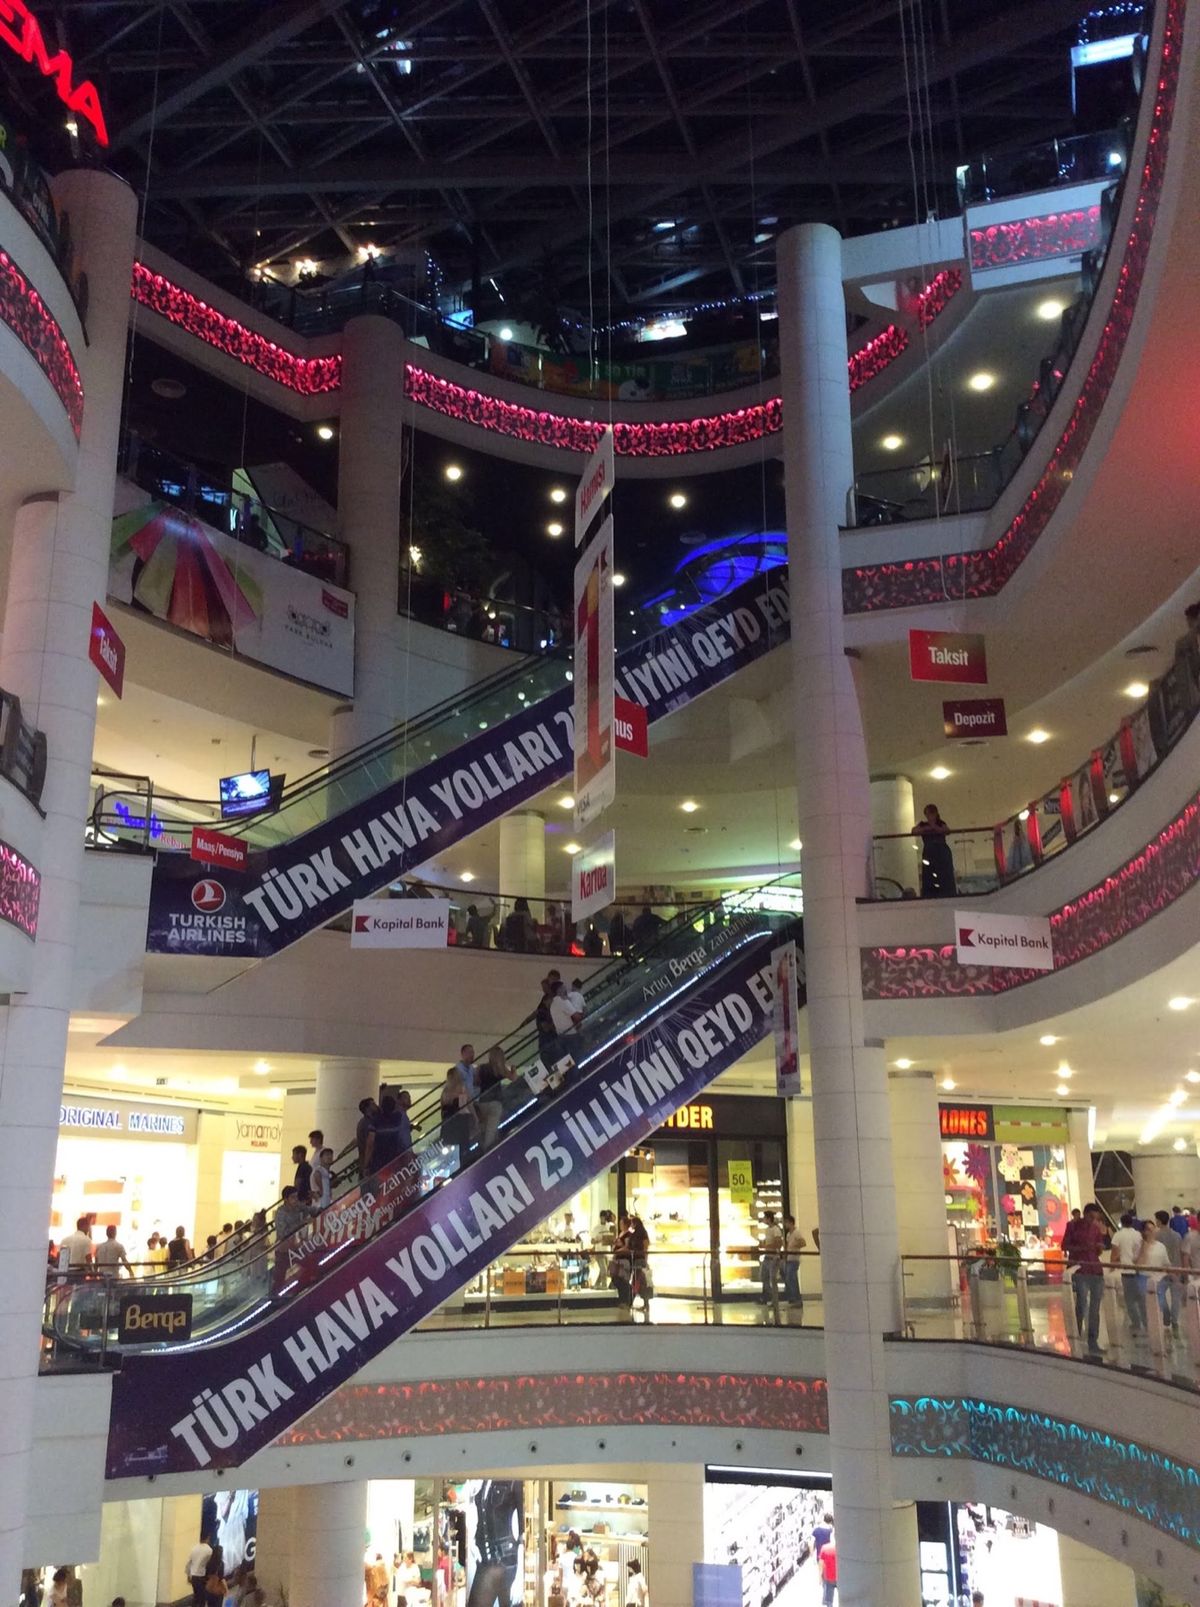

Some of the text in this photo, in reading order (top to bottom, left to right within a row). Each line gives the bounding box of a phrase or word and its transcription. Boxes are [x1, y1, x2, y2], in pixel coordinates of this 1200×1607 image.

[928, 646, 969, 666] Taksit
[614, 718, 633, 741] nus
[954, 711, 996, 727] Depozit
[243, 846, 351, 933] TÜRK
[341, 796, 442, 877] HAVA
[428, 723, 564, 820] YOLLARI
[691, 607, 761, 668] QEYD
[169, 913, 246, 929] TURKISH
[373, 917, 445, 932] Kapital Bank
[168, 928, 246, 943] AIRLINES
[978, 933, 1049, 949] Kapital Bank
[59, 1105, 184, 1135] ORIGINAL MARINES
[325, 1192, 377, 1234] Berqa
[170, 1353, 295, 1467] TÜRK
[283, 1276, 399, 1384] HAVA
[385, 1163, 535, 1298] YOLLARI
[525, 1131, 574, 1191] 25
[561, 1039, 685, 1158] İLLİYİNİ
[677, 992, 754, 1069] QEYD
[124, 1304, 186, 1334] Berqa
